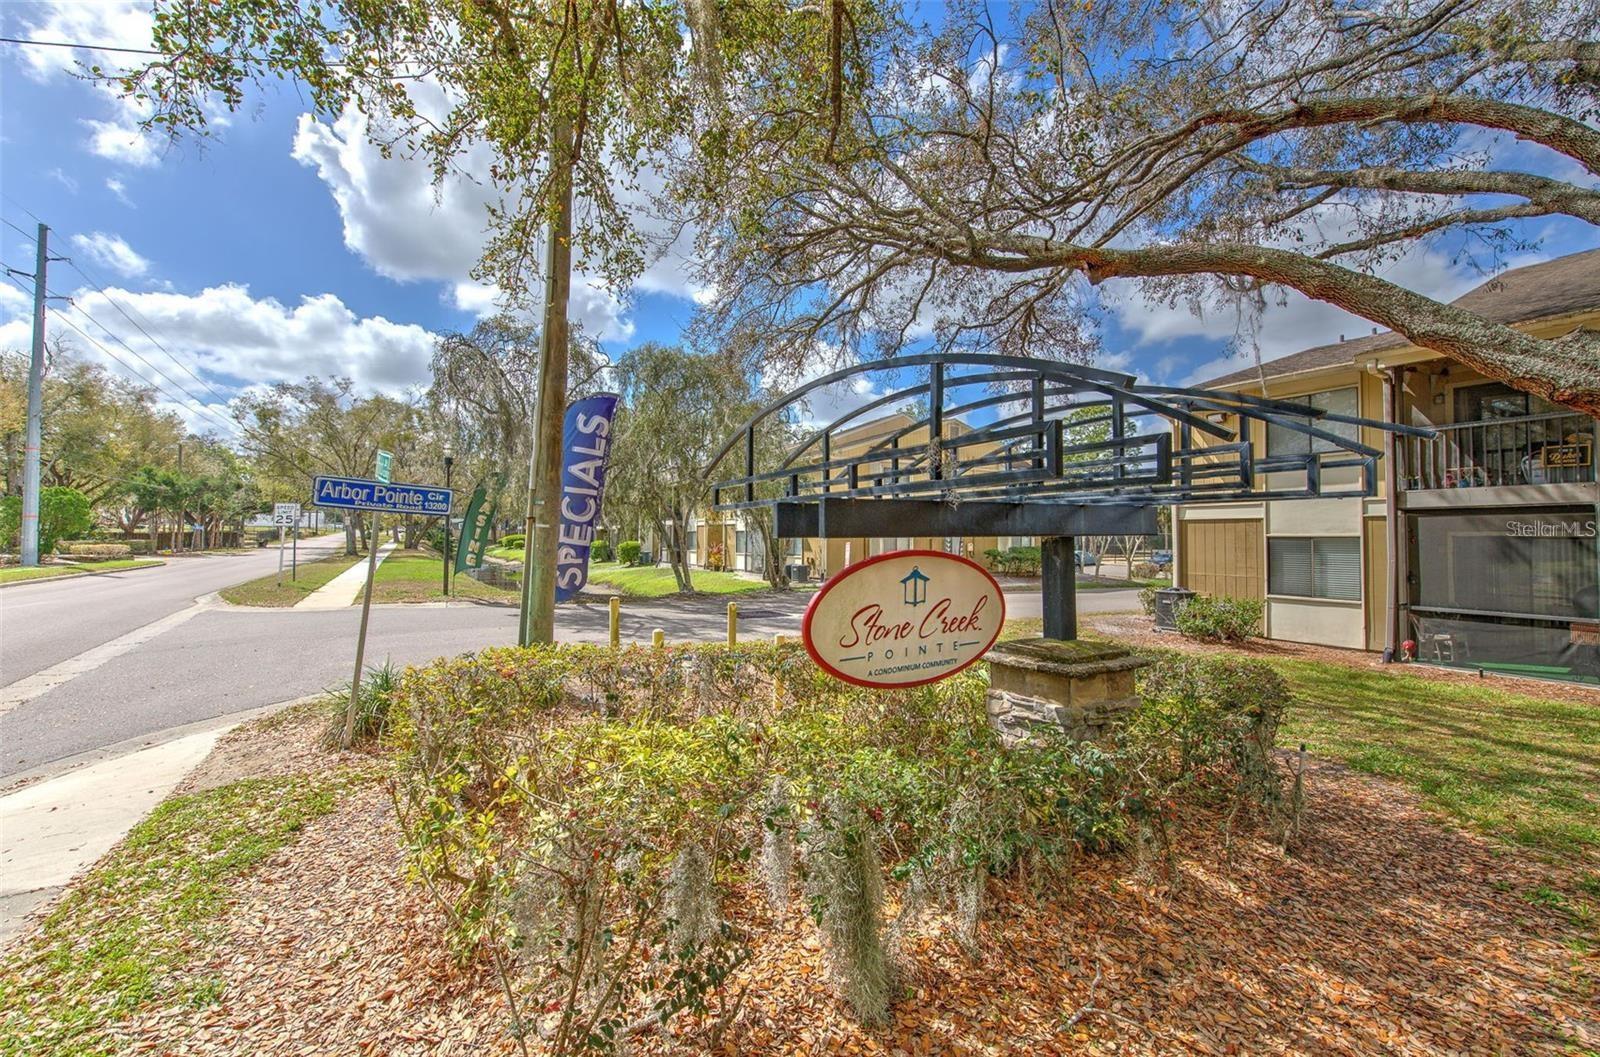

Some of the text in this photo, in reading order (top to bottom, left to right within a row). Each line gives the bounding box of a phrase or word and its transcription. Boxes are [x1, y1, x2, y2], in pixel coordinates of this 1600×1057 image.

[320, 481, 445, 506] Arbor Pointe Cir
[558, 412, 609, 591] SPECIALS
[424, 501, 448, 511] 13200
[275, 514, 294, 524] 25
[840, 604, 914, 648] Stone
[866, 642, 960, 662] POINTE
[874, 663, 920, 676] CONDOMINIUM
[921, 658, 958, 669] COMMUNITY
